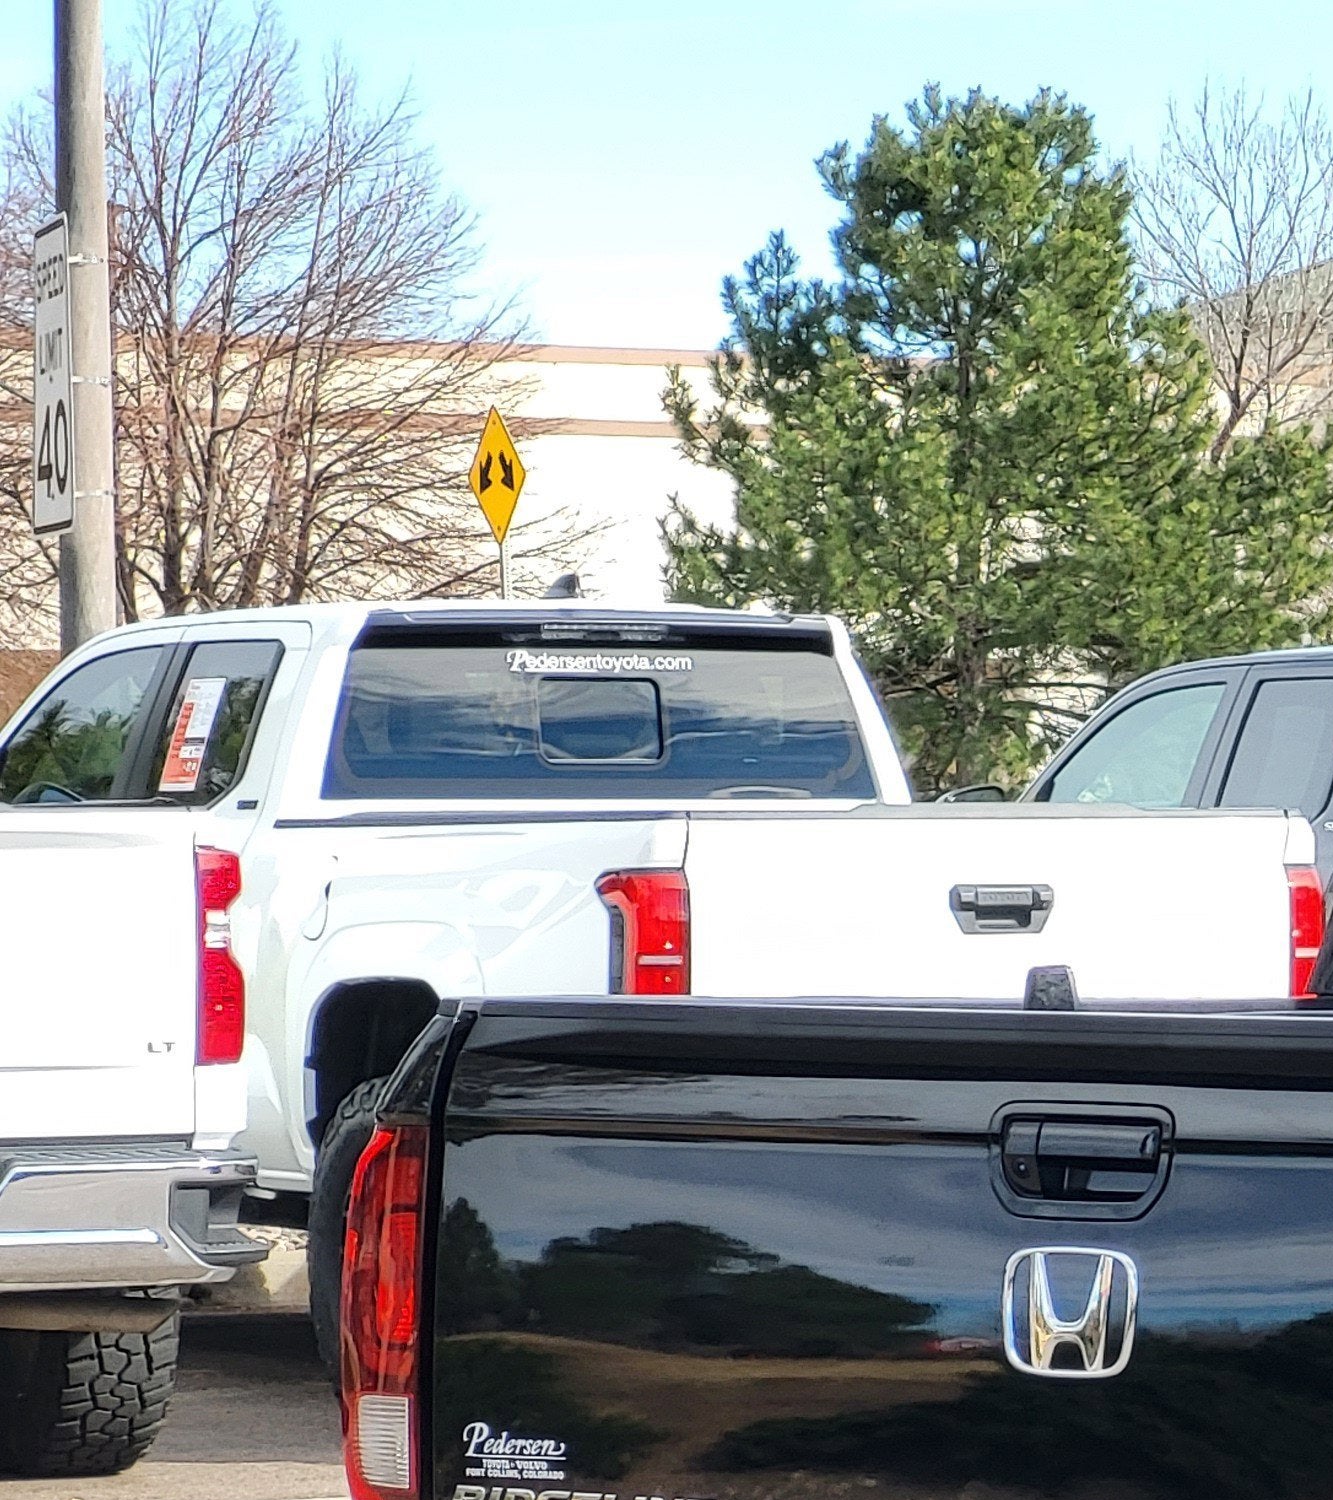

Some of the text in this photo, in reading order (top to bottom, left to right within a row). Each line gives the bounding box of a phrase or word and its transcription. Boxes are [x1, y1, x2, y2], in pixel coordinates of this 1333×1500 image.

[37, 399, 69, 498] 40
[507, 650, 692, 673] Pedersentoyota.com
[147, 1041, 176, 1053] LT
[463, 1422, 566, 1459] Pedersen
[515, 1460, 548, 1470] VOLVO
